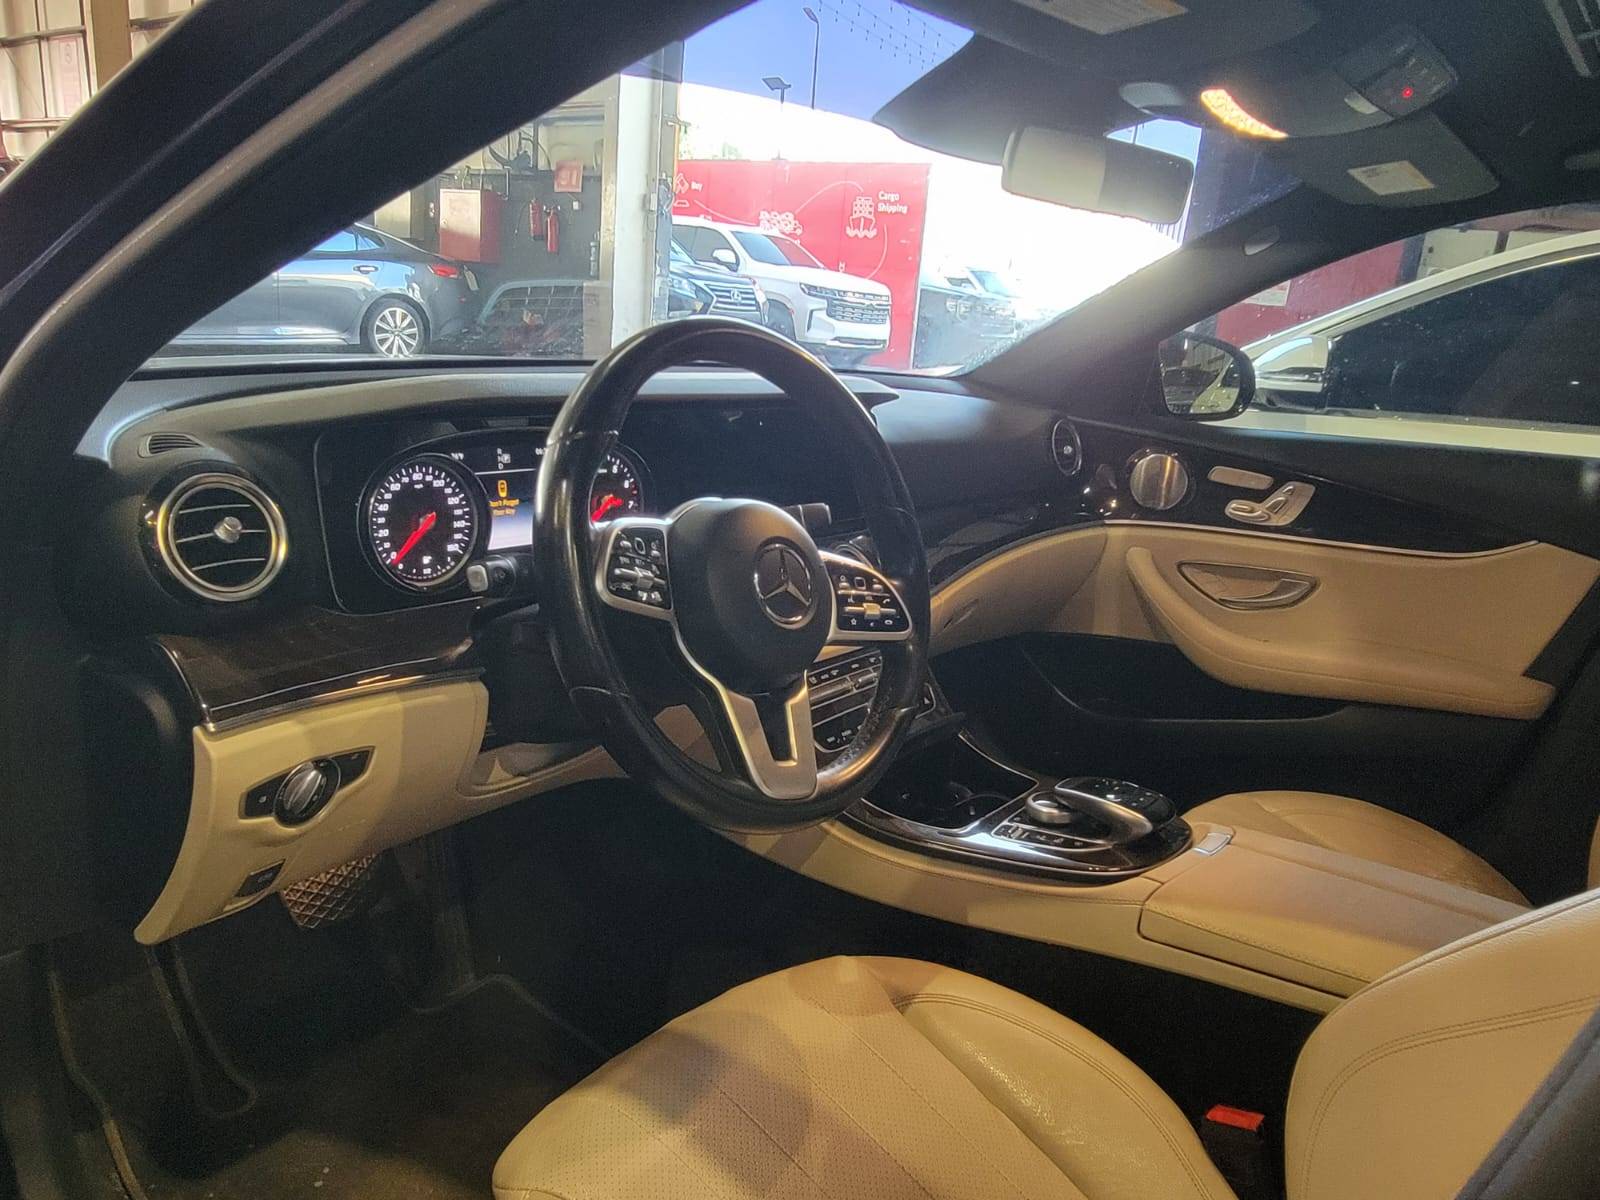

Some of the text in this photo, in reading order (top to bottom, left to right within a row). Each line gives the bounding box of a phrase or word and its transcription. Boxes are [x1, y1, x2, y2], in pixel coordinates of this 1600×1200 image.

[878, 190, 900, 202] Cargo
[877, 202, 908, 214] Shipping
[447, 497, 460, 505] 120
[378, 503, 389, 511] 40
